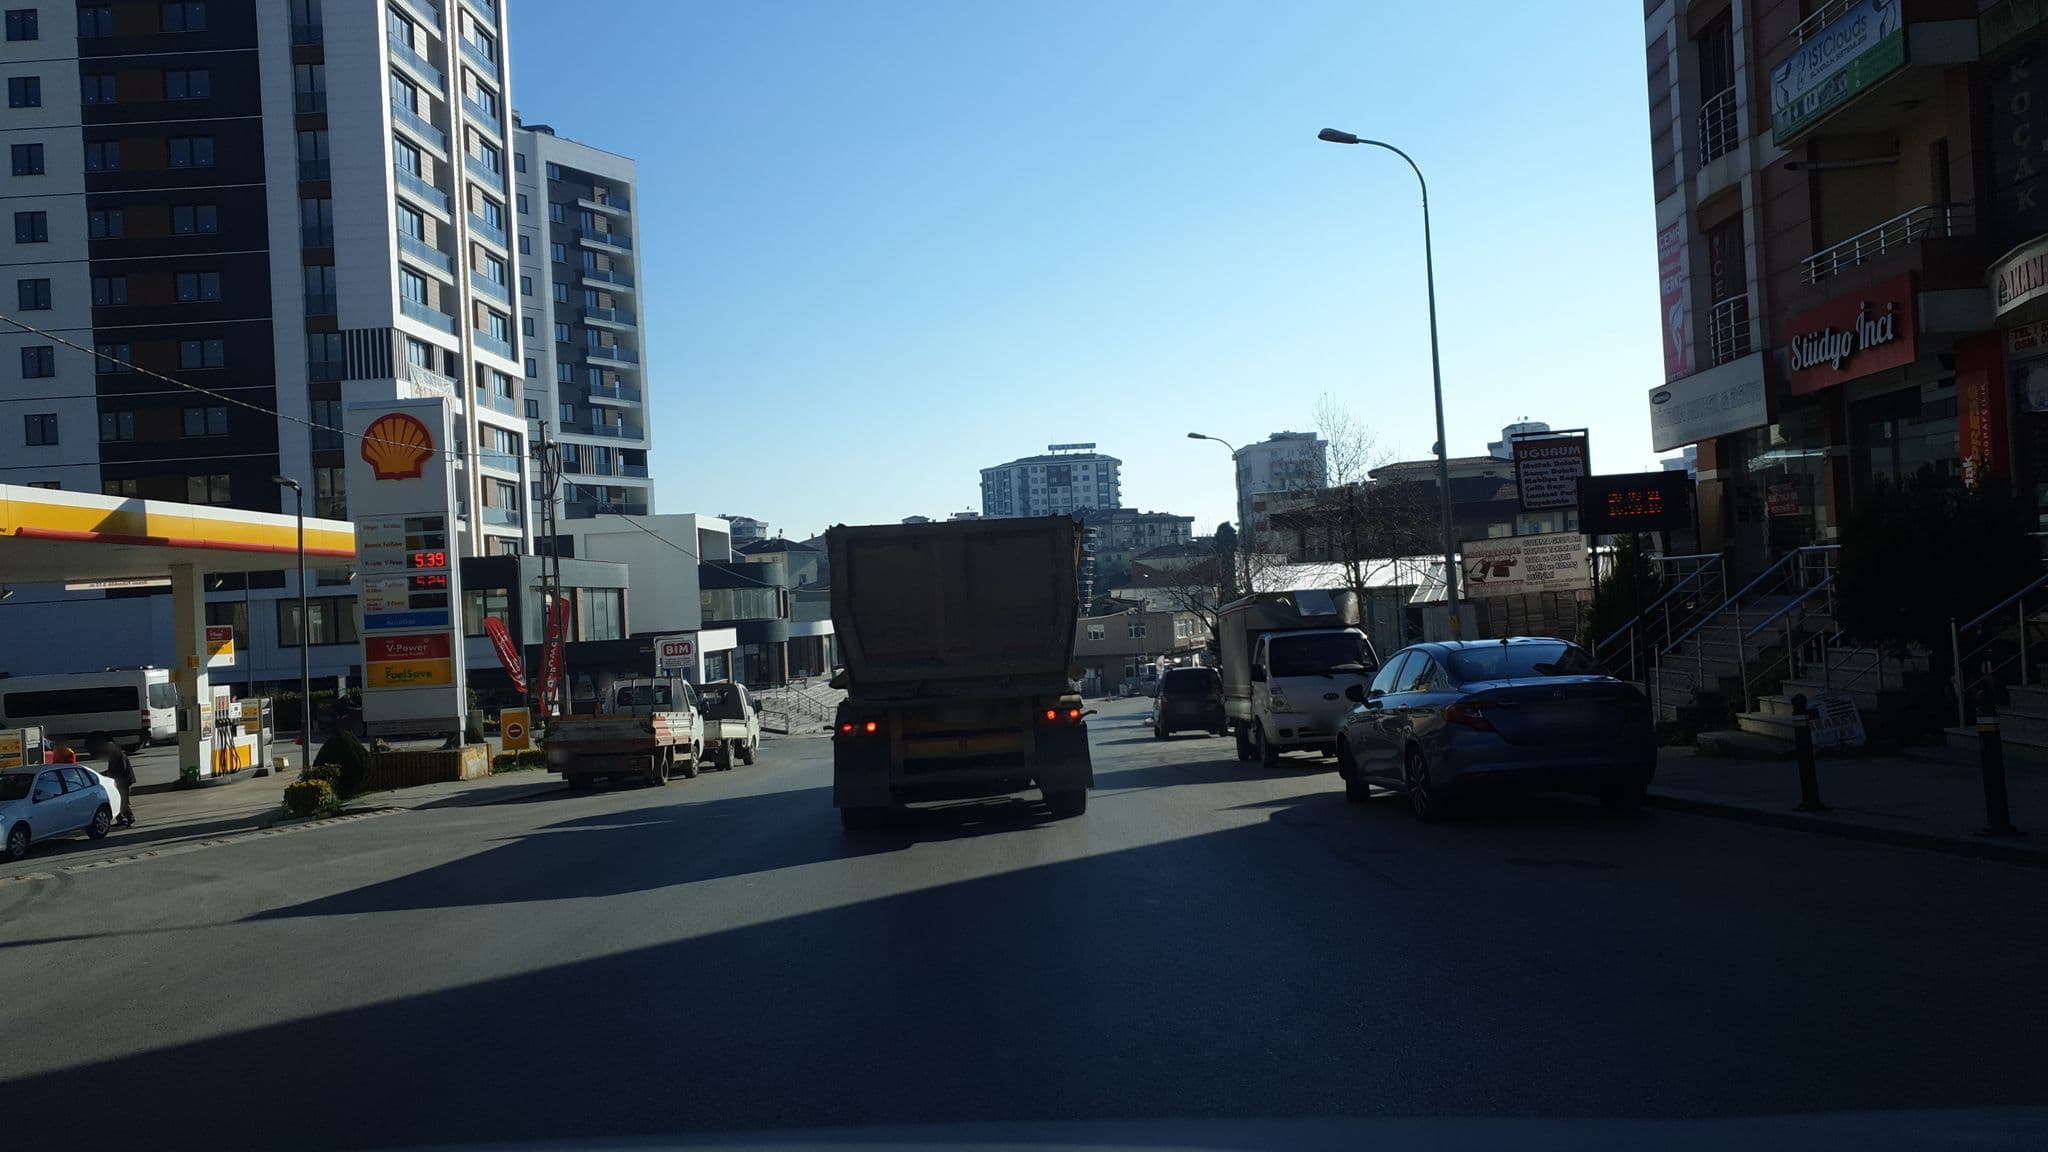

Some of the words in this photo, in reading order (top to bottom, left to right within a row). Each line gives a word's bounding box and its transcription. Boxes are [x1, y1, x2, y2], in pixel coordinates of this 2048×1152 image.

[1791, 327, 1854, 371] Stüdyo
[1855, 301, 1894, 350] İnci
[415, 553, 445, 568] 5.39
[386, 644, 428, 653] V-Power
[385, 668, 433, 680] FuelSave
